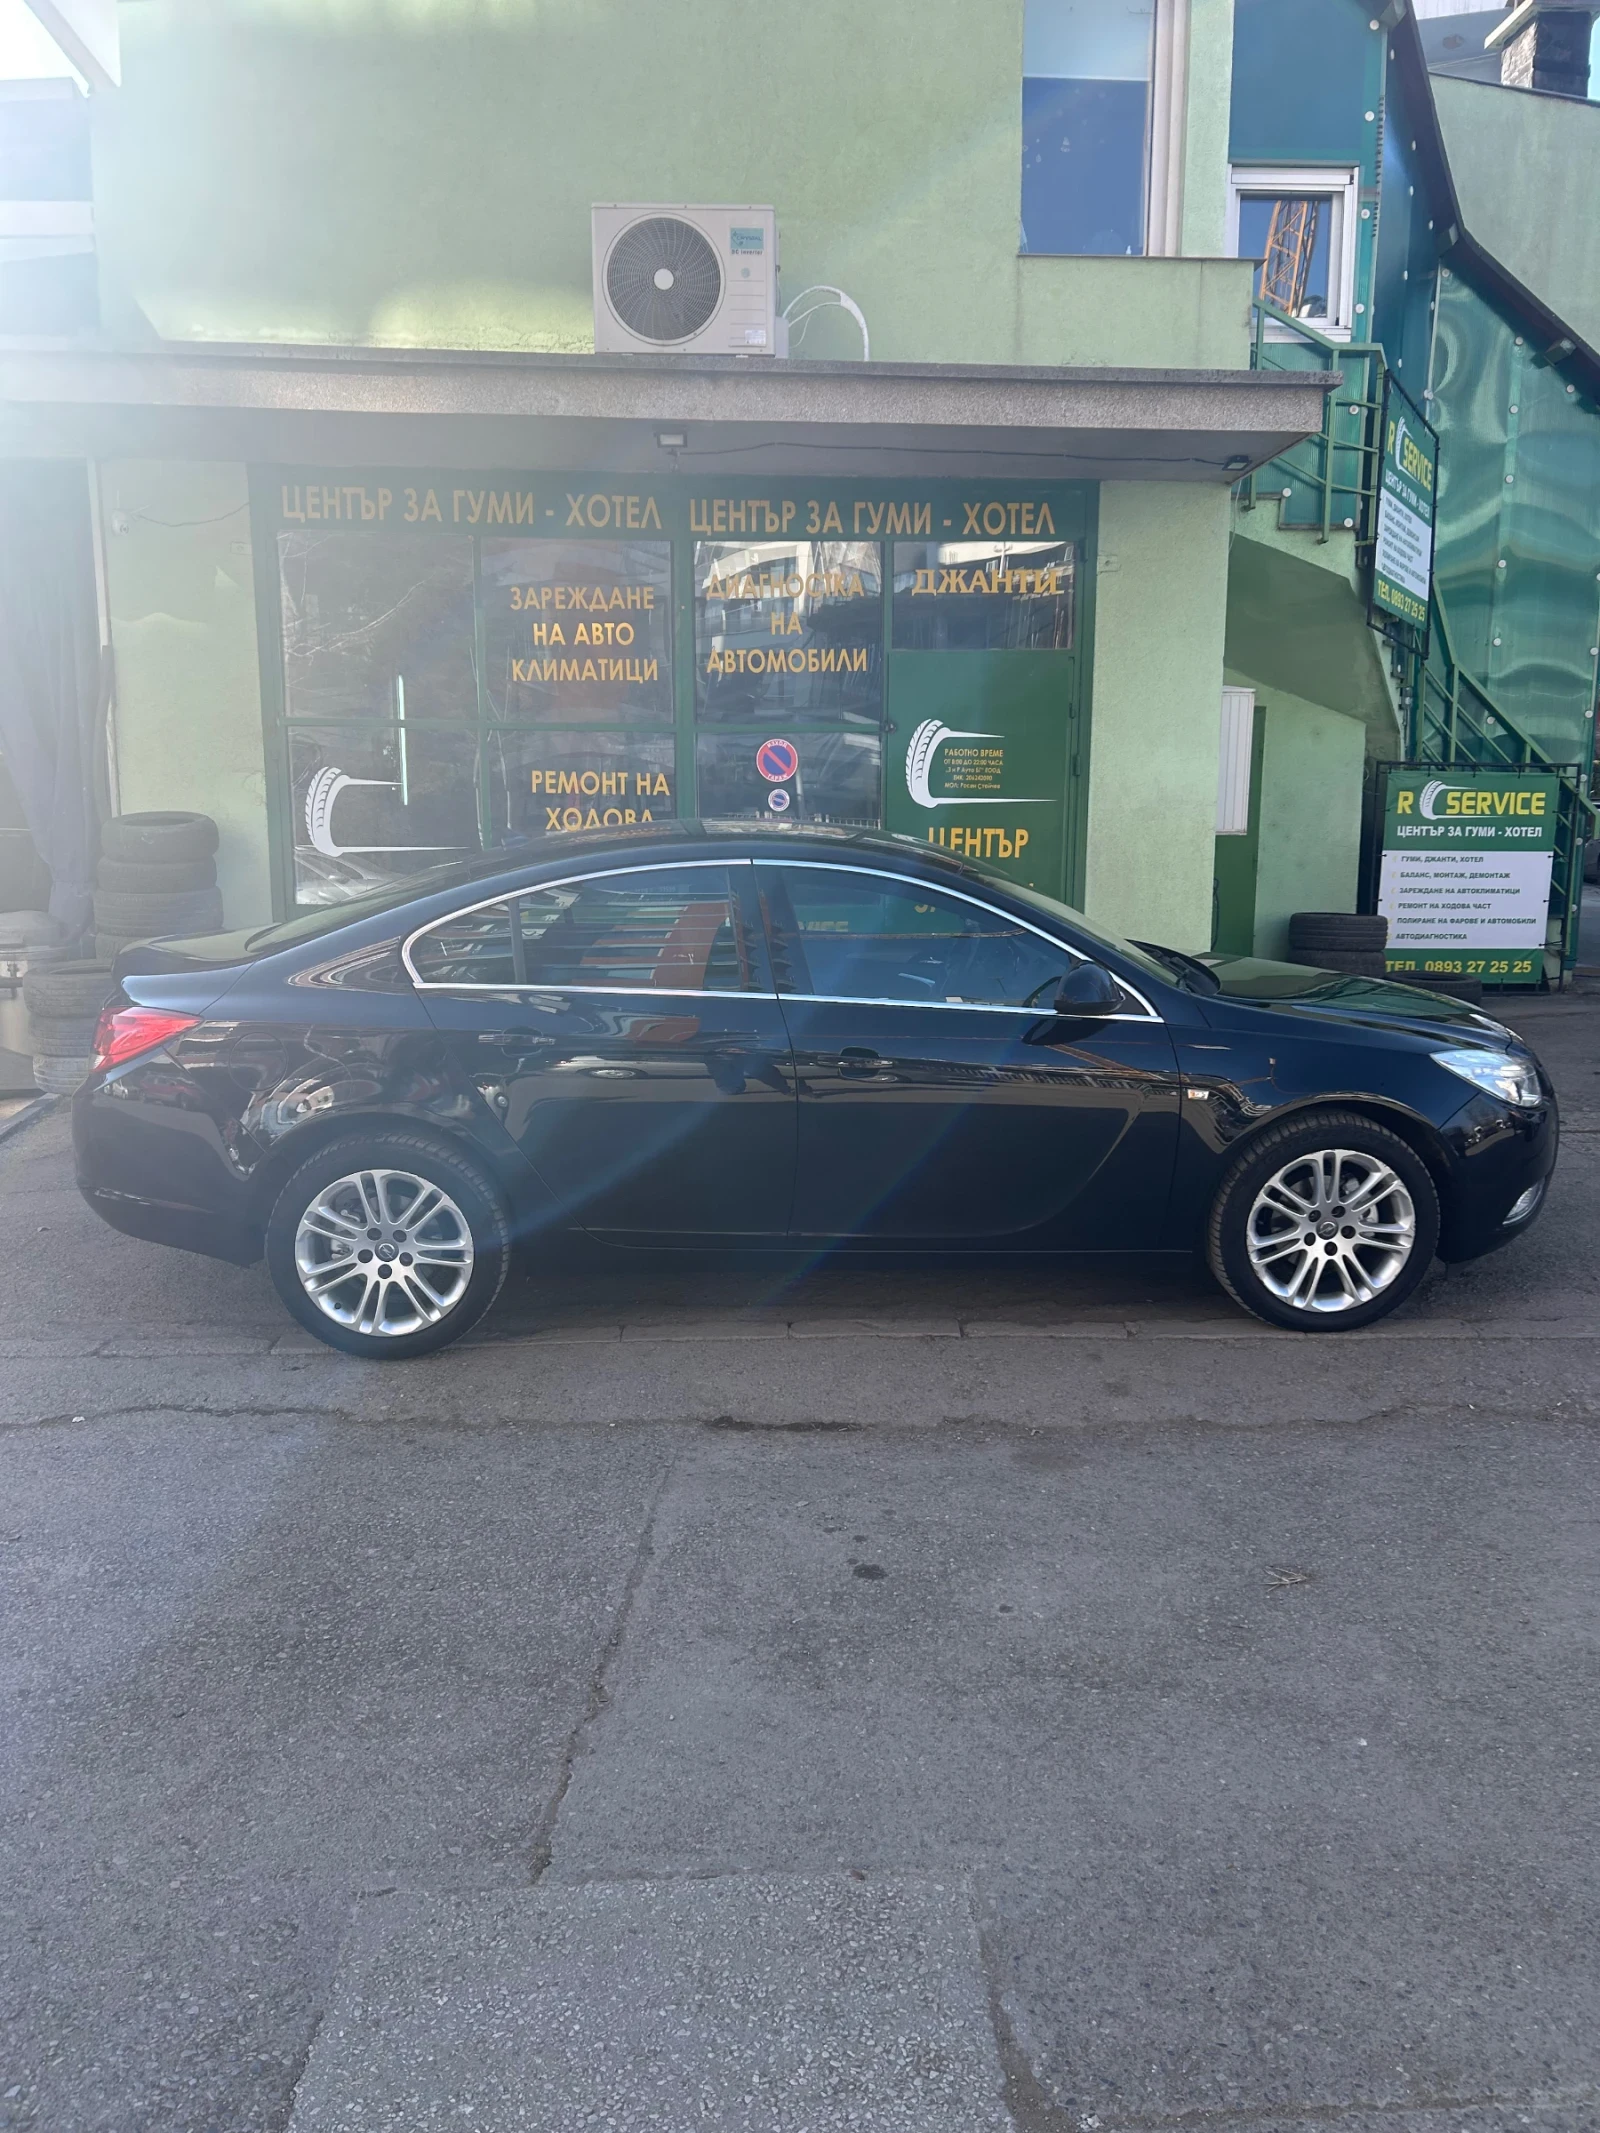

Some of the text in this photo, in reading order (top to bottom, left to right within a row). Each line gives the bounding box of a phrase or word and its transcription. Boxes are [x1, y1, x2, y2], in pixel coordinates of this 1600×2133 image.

[1387, 420, 1432, 492] R SERVICE
[281, 485, 393, 524] ЦЕНТЪР
[404, 488, 442, 522] ЗА
[453, 490, 534, 525] ГУМИ
[565, 493, 662, 530] ХОТЕЛ
[690, 498, 796, 536] ЦЕНТЪР
[806, 500, 843, 534] ЗА
[854, 502, 932, 535] ГУМИ
[962, 502, 1056, 536] ХОТЕЛ
[911, 569, 1060, 597] ДЖАНТИ
[510, 586, 654, 612] ЗАРЕЖДАНЕ
[533, 622, 634, 646] НА АВТО
[771, 612, 803, 635] НА
[512, 658, 658, 684] КЛИМАТИЦИ
[706, 648, 867, 674] АВТОМОБИЛИ
[944, 748, 979, 756] РАБОТНО
[532, 770, 670, 796] РЕМОНТ НА
[1397, 791, 1546, 815] R SERVICE
[1397, 826, 1445, 838] ЦЕНТЪР
[1448, 826, 1462, 836] ЗА
[1465, 826, 1495, 837] ГУМИ
[1504, 827, 1542, 837] ХОТЕЛ
[1425, 961, 1462, 973] 0893
[1466, 961, 1486, 973] 27
[1490, 961, 1509, 973] 25
[1513, 961, 1532, 973] 25
